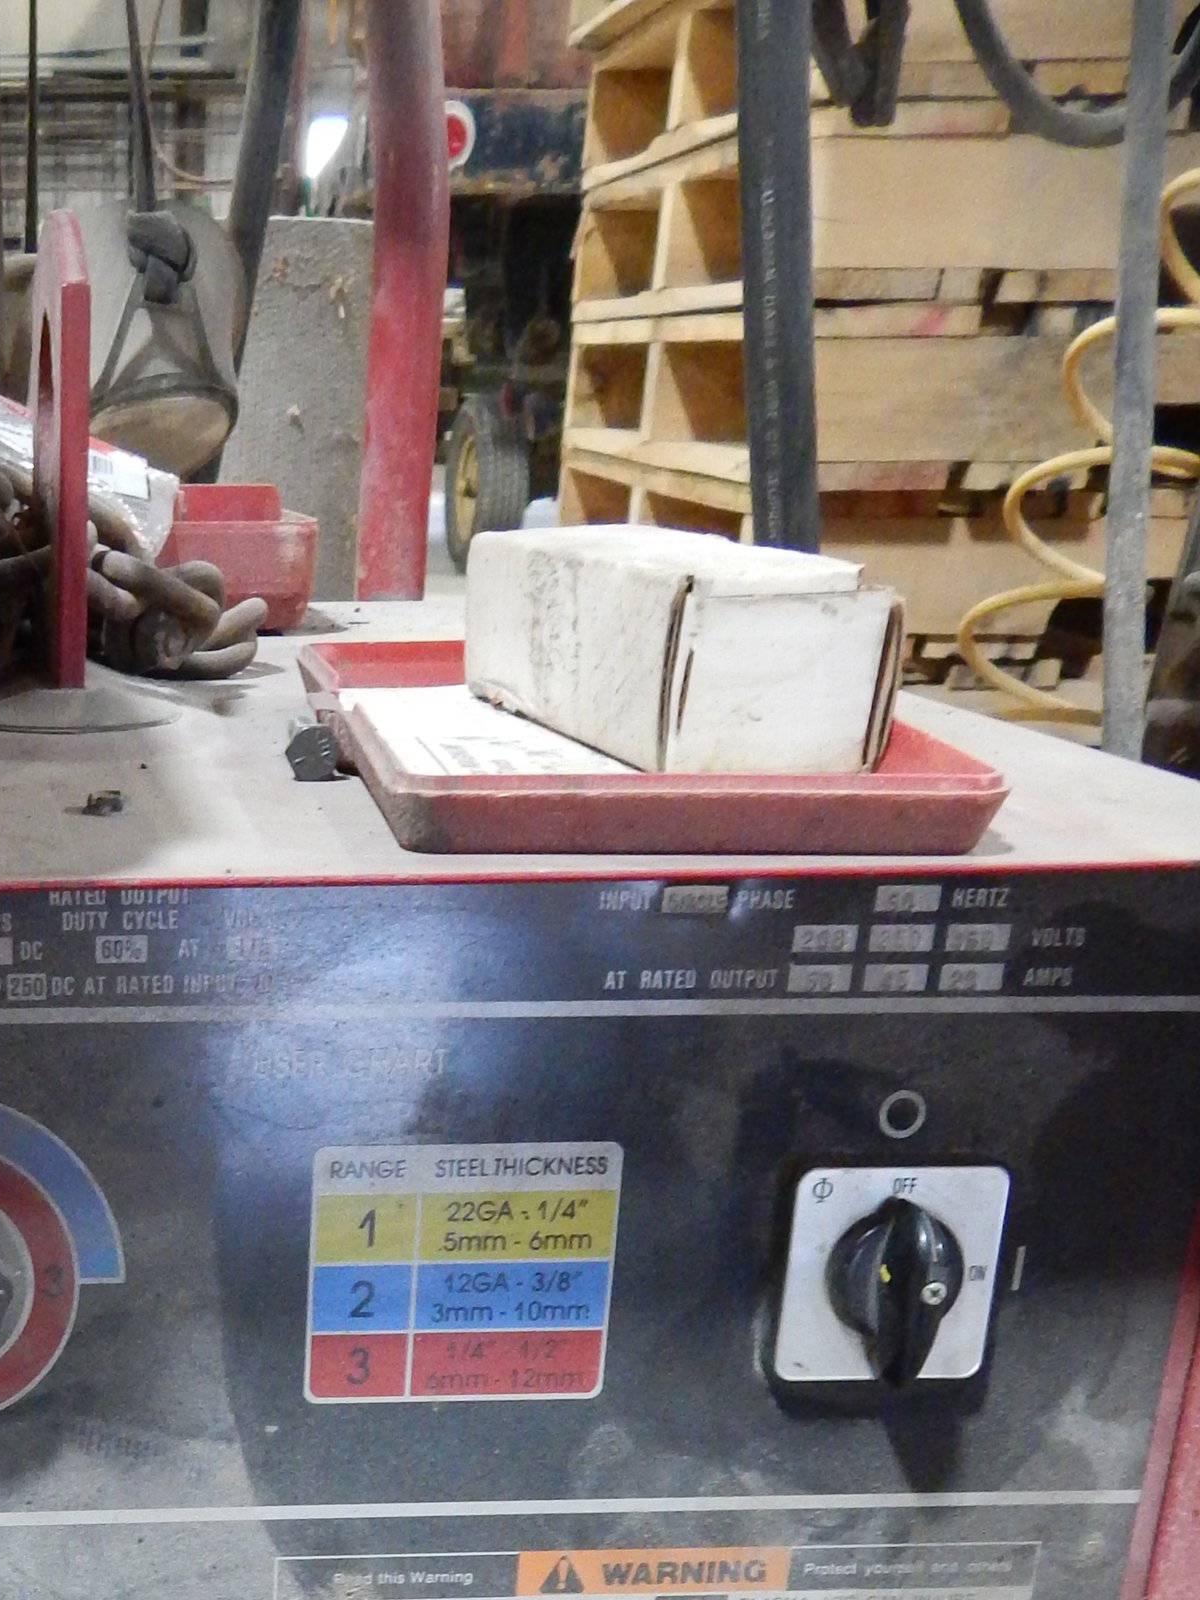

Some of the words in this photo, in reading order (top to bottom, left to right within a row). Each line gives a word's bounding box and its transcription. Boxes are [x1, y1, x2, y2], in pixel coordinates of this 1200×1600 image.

[600, 889, 653, 911] INPUT
[735, 887, 796, 910] PHASE
[951, 887, 1011, 908] HERTZ
[61, 911, 109, 931] DUTY
[122, 909, 179, 931] CYCLE
[1031, 926, 1086, 948] VOLTS
[19, 940, 44, 960] DC
[101, 939, 143, 961] 60%
[178, 938, 201, 959] AT
[9, 976, 46, 998] 250
[84, 975, 106, 995] AT
[116, 975, 174, 995] RATED
[603, 970, 629, 990] AT
[639, 969, 698, 989] RATED
[710, 968, 780, 989] OUTPUT
[1023, 966, 1073, 987] AMPS
[329, 1158, 408, 1180] RANGE
[892, 1177, 918, 1196] OFF
[445, 1200, 514, 1223] 22GA
[357, 1209, 378, 1249] 1
[528, 1230, 593, 1251] 6mm
[444, 1271, 510, 1294] 12GA
[348, 1280, 376, 1319] 2
[431, 1303, 493, 1323] 3mm
[514, 1301, 591, 1322] 10mm
[345, 1346, 371, 1386] 3
[377, 1570, 405, 1585] this
[409, 1570, 474, 1587] Warning
[602, 1558, 767, 1586] WARNING
[803, 1562, 857, 1576] Protect
